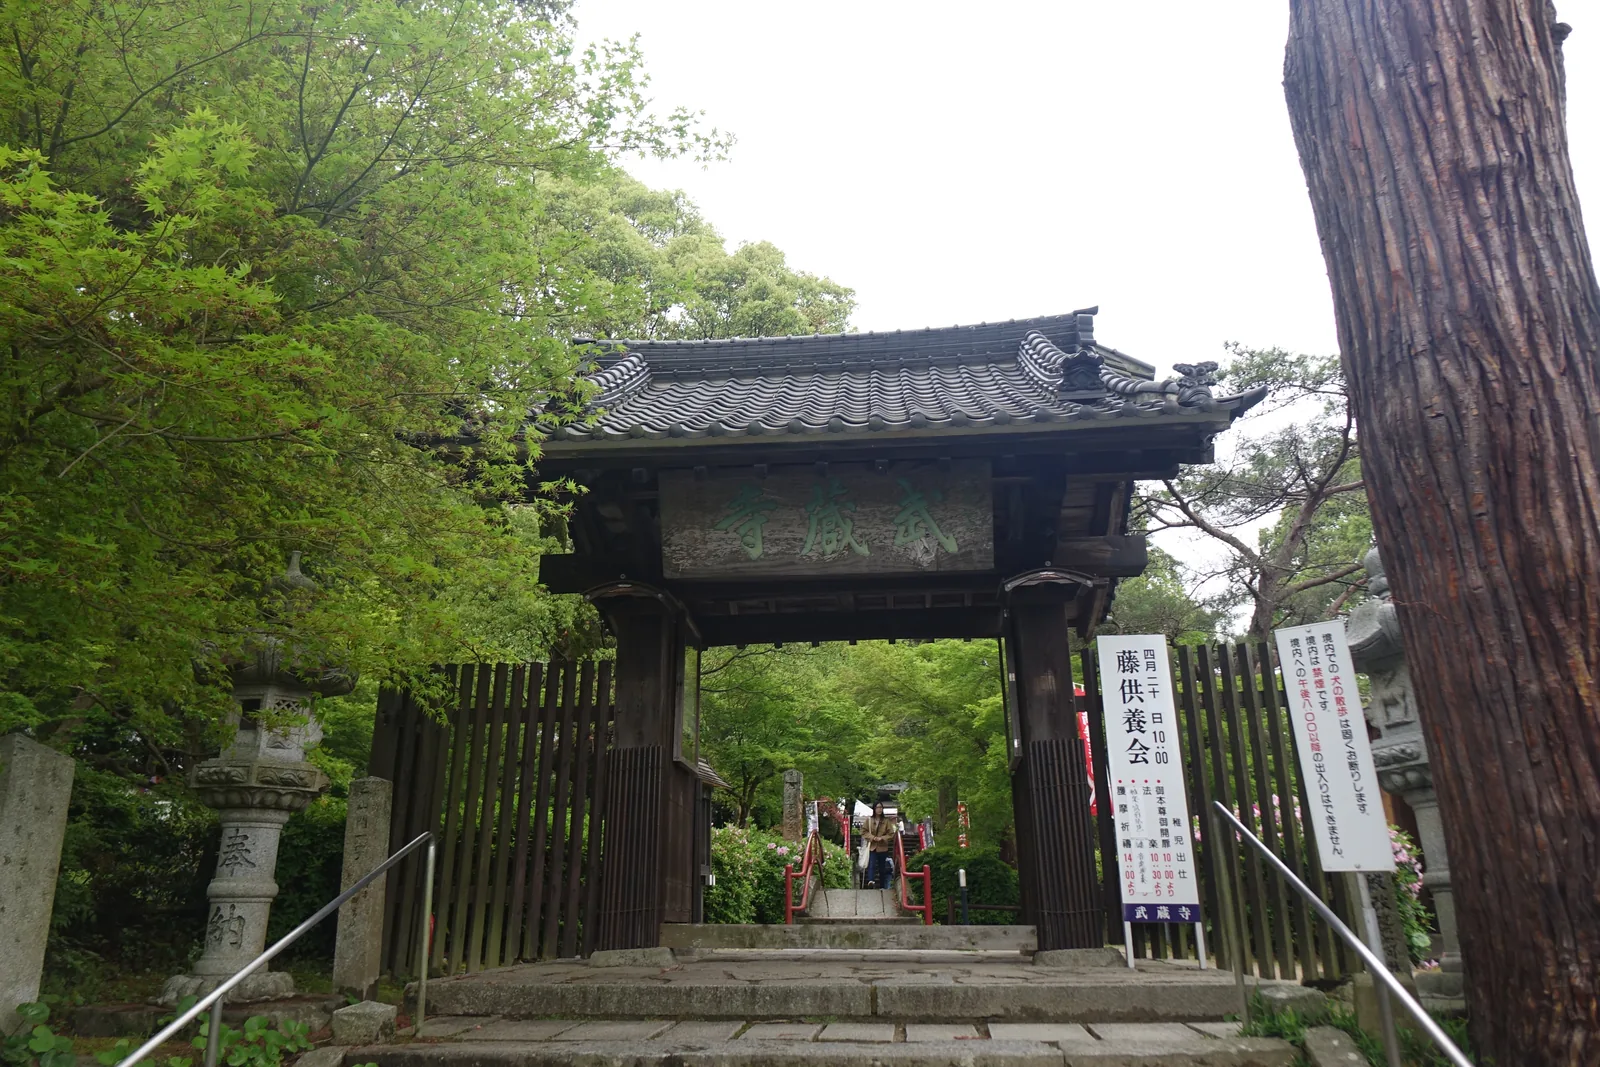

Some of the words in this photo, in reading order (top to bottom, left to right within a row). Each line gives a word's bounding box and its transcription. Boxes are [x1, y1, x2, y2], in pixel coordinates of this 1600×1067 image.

[1115, 649, 1151, 765] 藤供養会
[207, 828, 256, 950] 奉納
[1172, 817, 1188, 879] 稚児出仕
